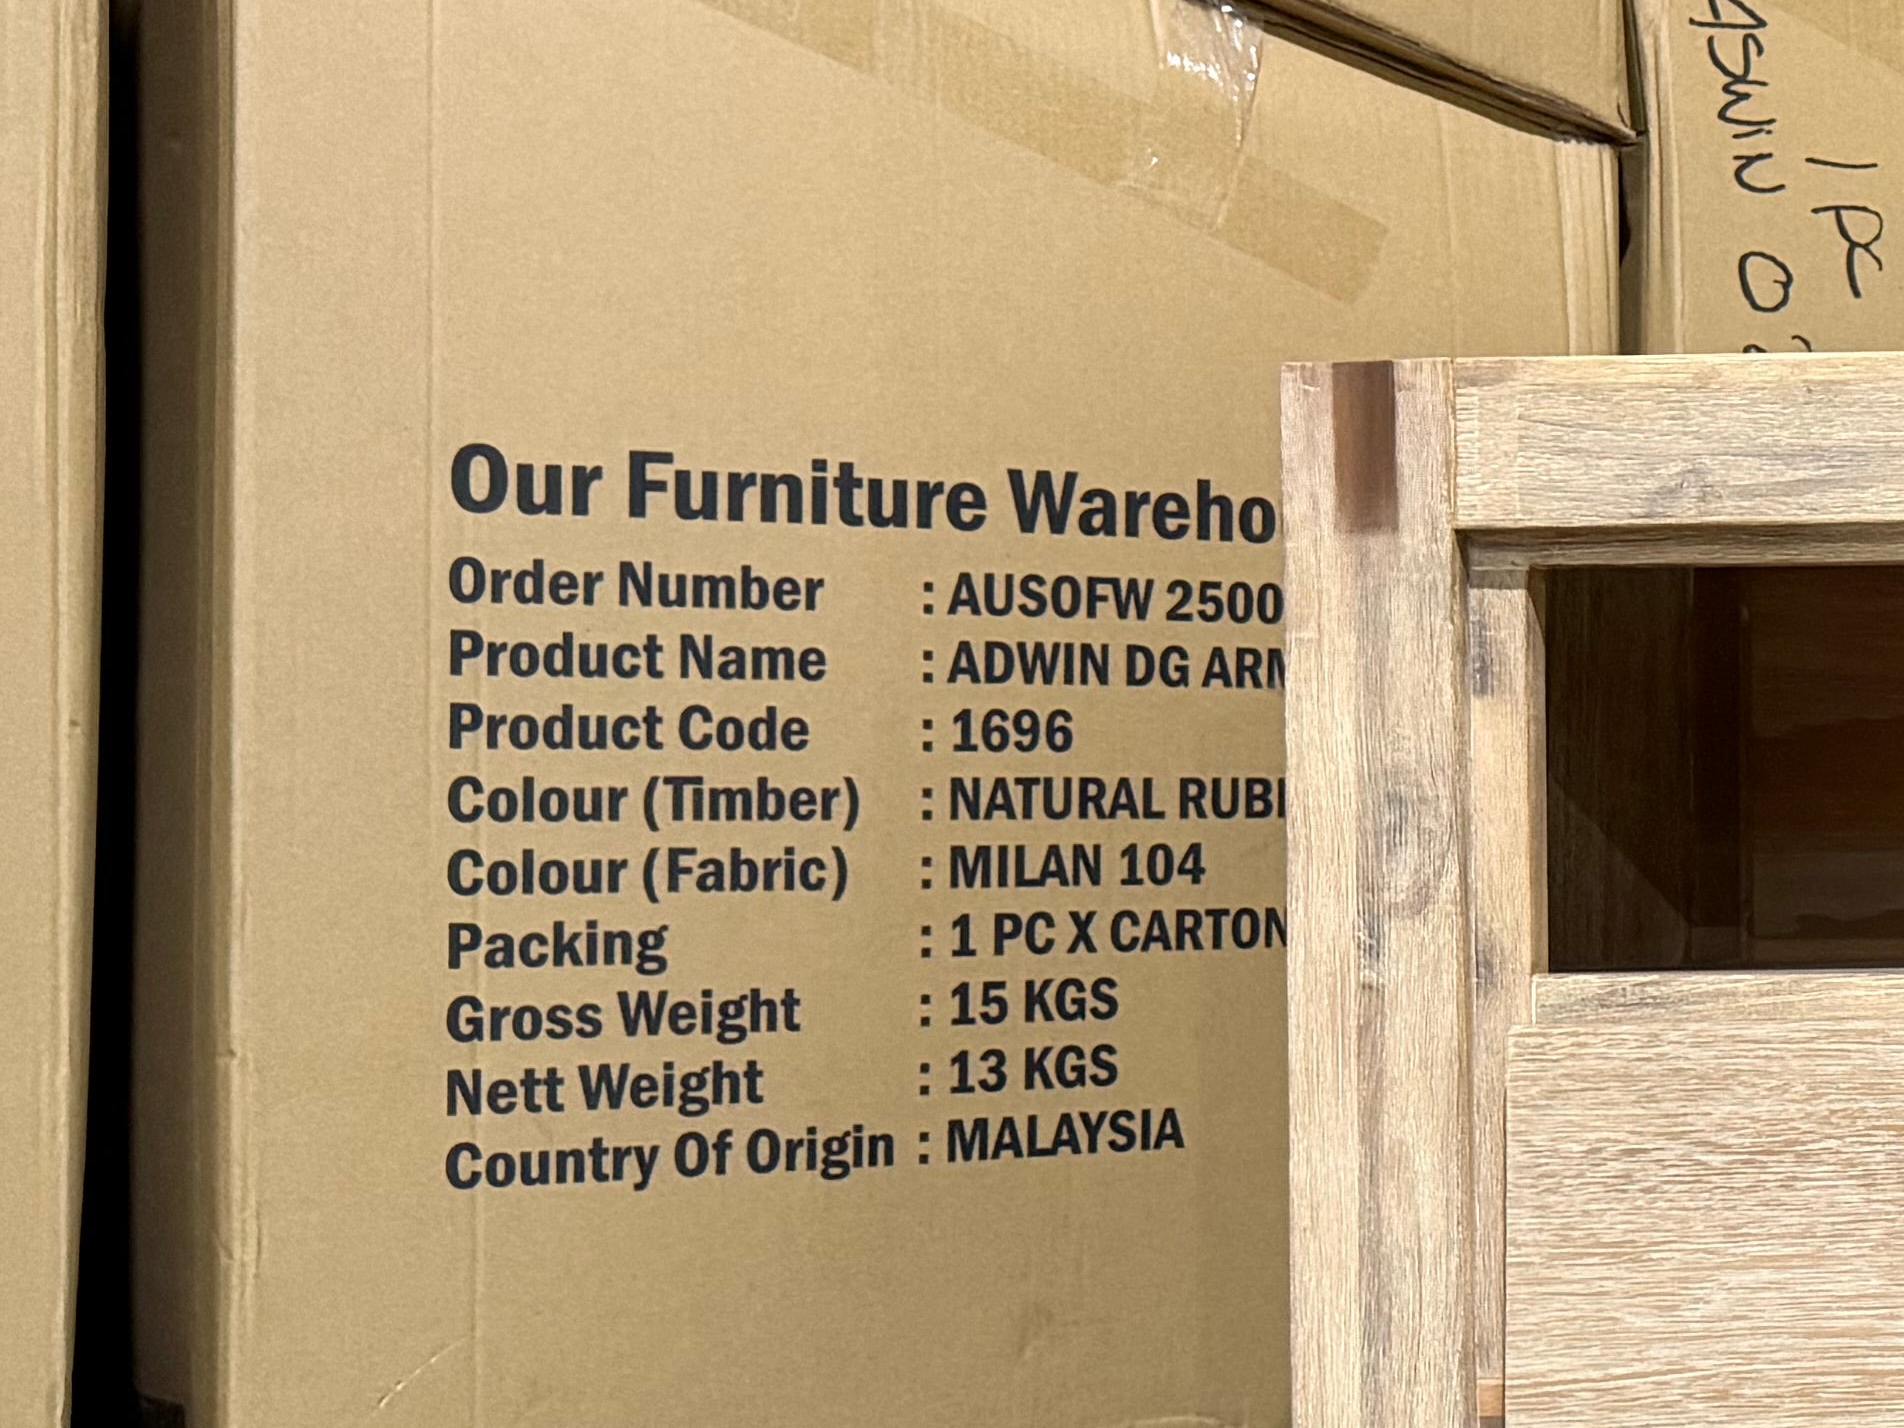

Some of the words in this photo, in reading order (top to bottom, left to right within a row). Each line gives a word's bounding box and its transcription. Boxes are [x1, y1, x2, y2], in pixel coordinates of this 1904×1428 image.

[450, 442, 604, 517] Our
[628, 449, 988, 532] Furniture
[1006, 467, 1277, 545] Wareho
[448, 555, 604, 607] Order
[618, 560, 825, 612] Number
[946, 571, 1155, 622] AUSOFW
[1165, 578, 1285, 625] 2500
[448, 702, 664, 751] Product
[677, 703, 810, 752] Code
[952, 708, 1074, 754] 1696
[446, 848, 629, 897] Colour
[642, 845, 848, 905] (Fabric)
[949, 843, 1102, 890] MILAN
[1119, 842, 1207, 887] 104
[445, 994, 603, 1044] Gross
[616, 987, 801, 1046] Weight
[950, 980, 1009, 1027] 15
[1024, 976, 1119, 1024] KGS
[445, 1136, 661, 1192] Country
[673, 1128, 734, 1178] Of
[746, 1123, 895, 1181] Origin
[946, 1107, 1186, 1164] MALAYSIA
